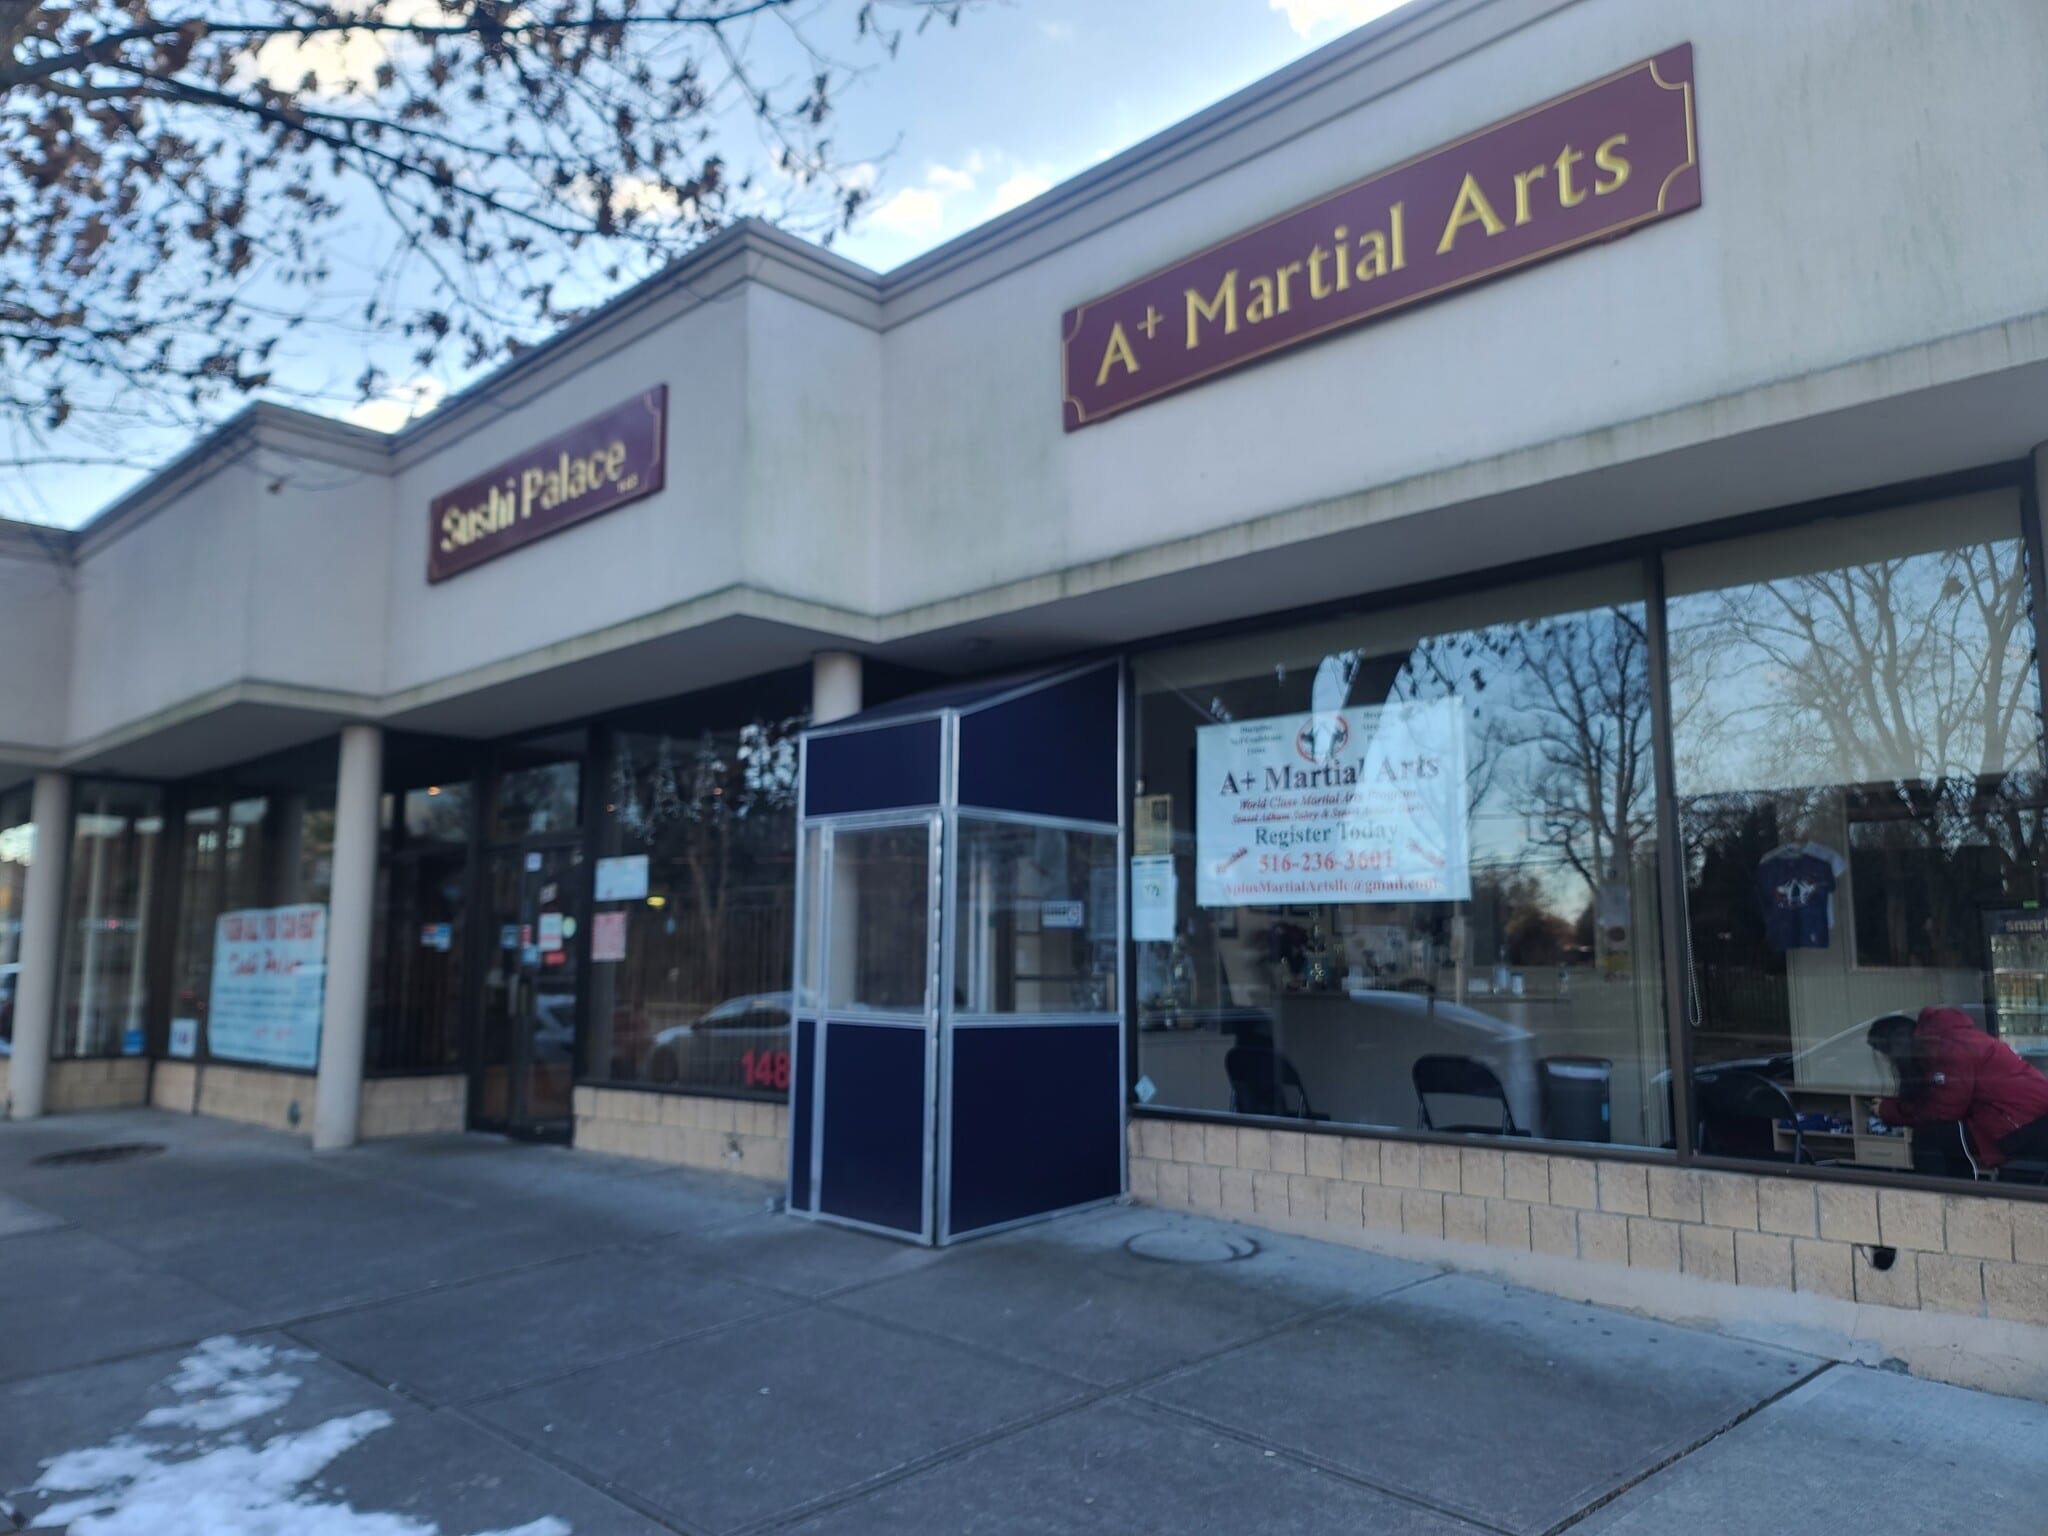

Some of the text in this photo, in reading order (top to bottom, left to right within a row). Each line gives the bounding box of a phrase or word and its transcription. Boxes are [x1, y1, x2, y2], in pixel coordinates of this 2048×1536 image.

[1095, 131, 1631, 387] A+ Martial Arts
[440, 439, 627, 552] Sushi Palace
[1220, 753, 1440, 795] A+ Martial Arts
[1255, 821, 1399, 849] Register Today
